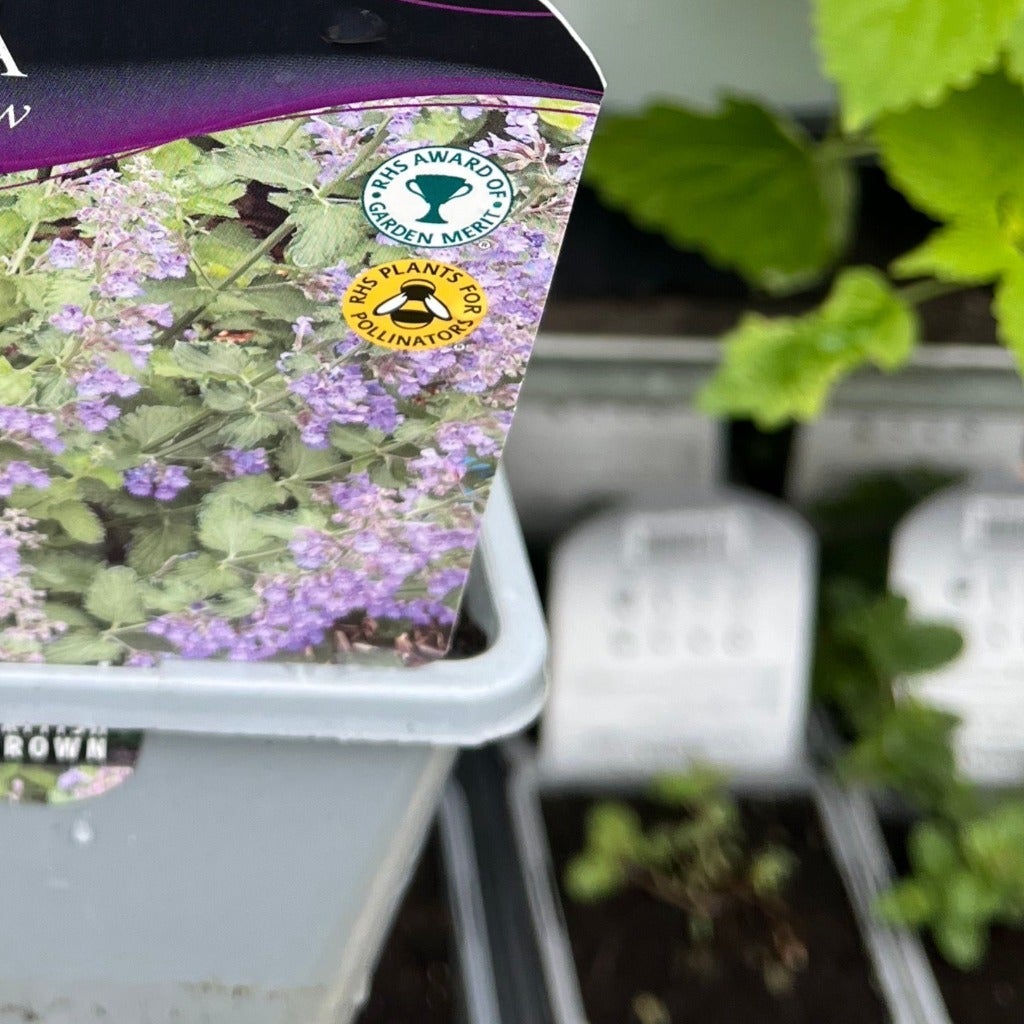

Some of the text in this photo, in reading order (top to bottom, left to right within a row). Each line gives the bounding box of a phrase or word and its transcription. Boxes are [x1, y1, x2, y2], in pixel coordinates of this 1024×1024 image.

[371, 150, 507, 198] RHS AWARD OF
[369, 201, 500, 245] GARDEN MERIT
[349, 262, 482, 314] RHS PLANTS FOR
[351, 311, 474, 347] POLLINATORS
